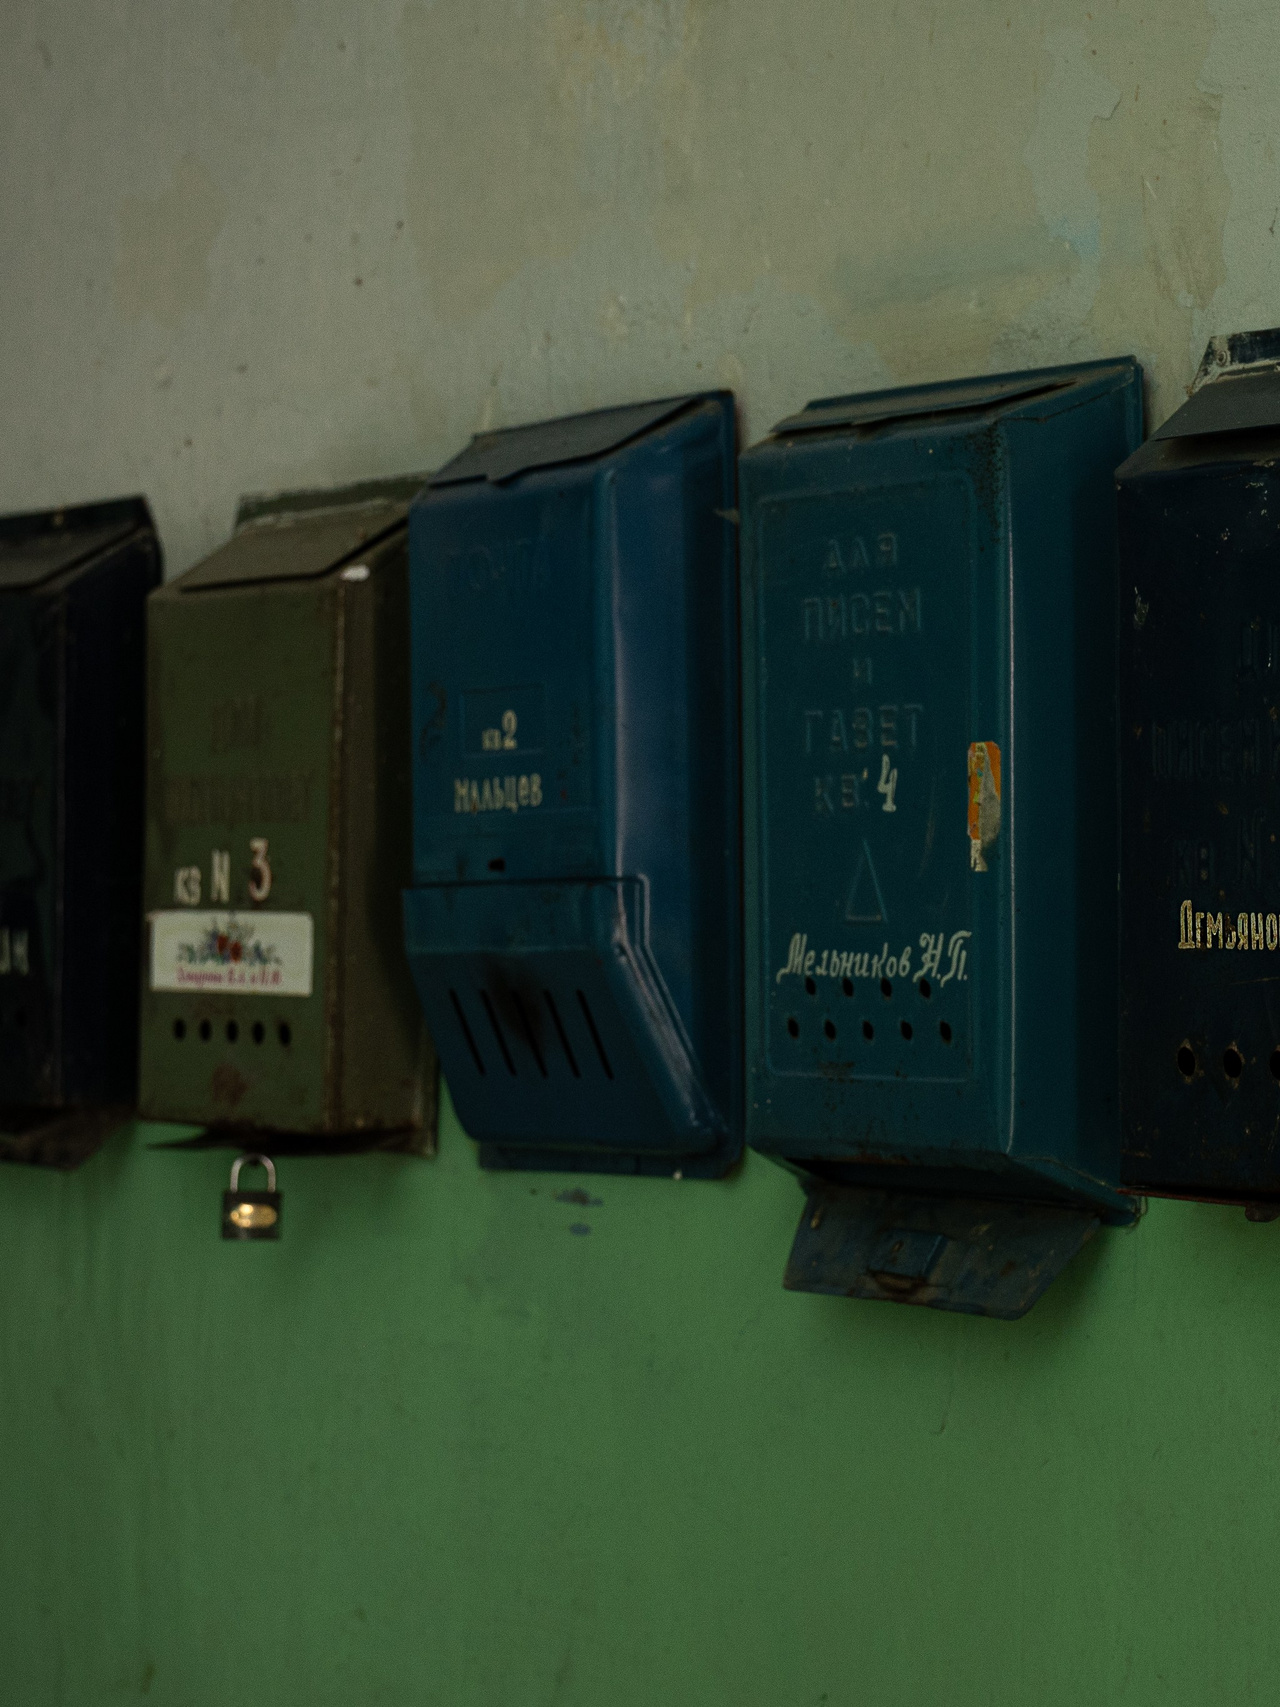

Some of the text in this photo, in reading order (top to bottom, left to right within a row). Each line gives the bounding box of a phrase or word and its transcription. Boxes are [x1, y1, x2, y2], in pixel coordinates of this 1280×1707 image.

[801, 586, 922, 642] ПИСЕМ
[803, 703, 924, 755] ГАЗЕТ
[876, 752, 898, 813] 4
[248, 836, 272, 902] 3
